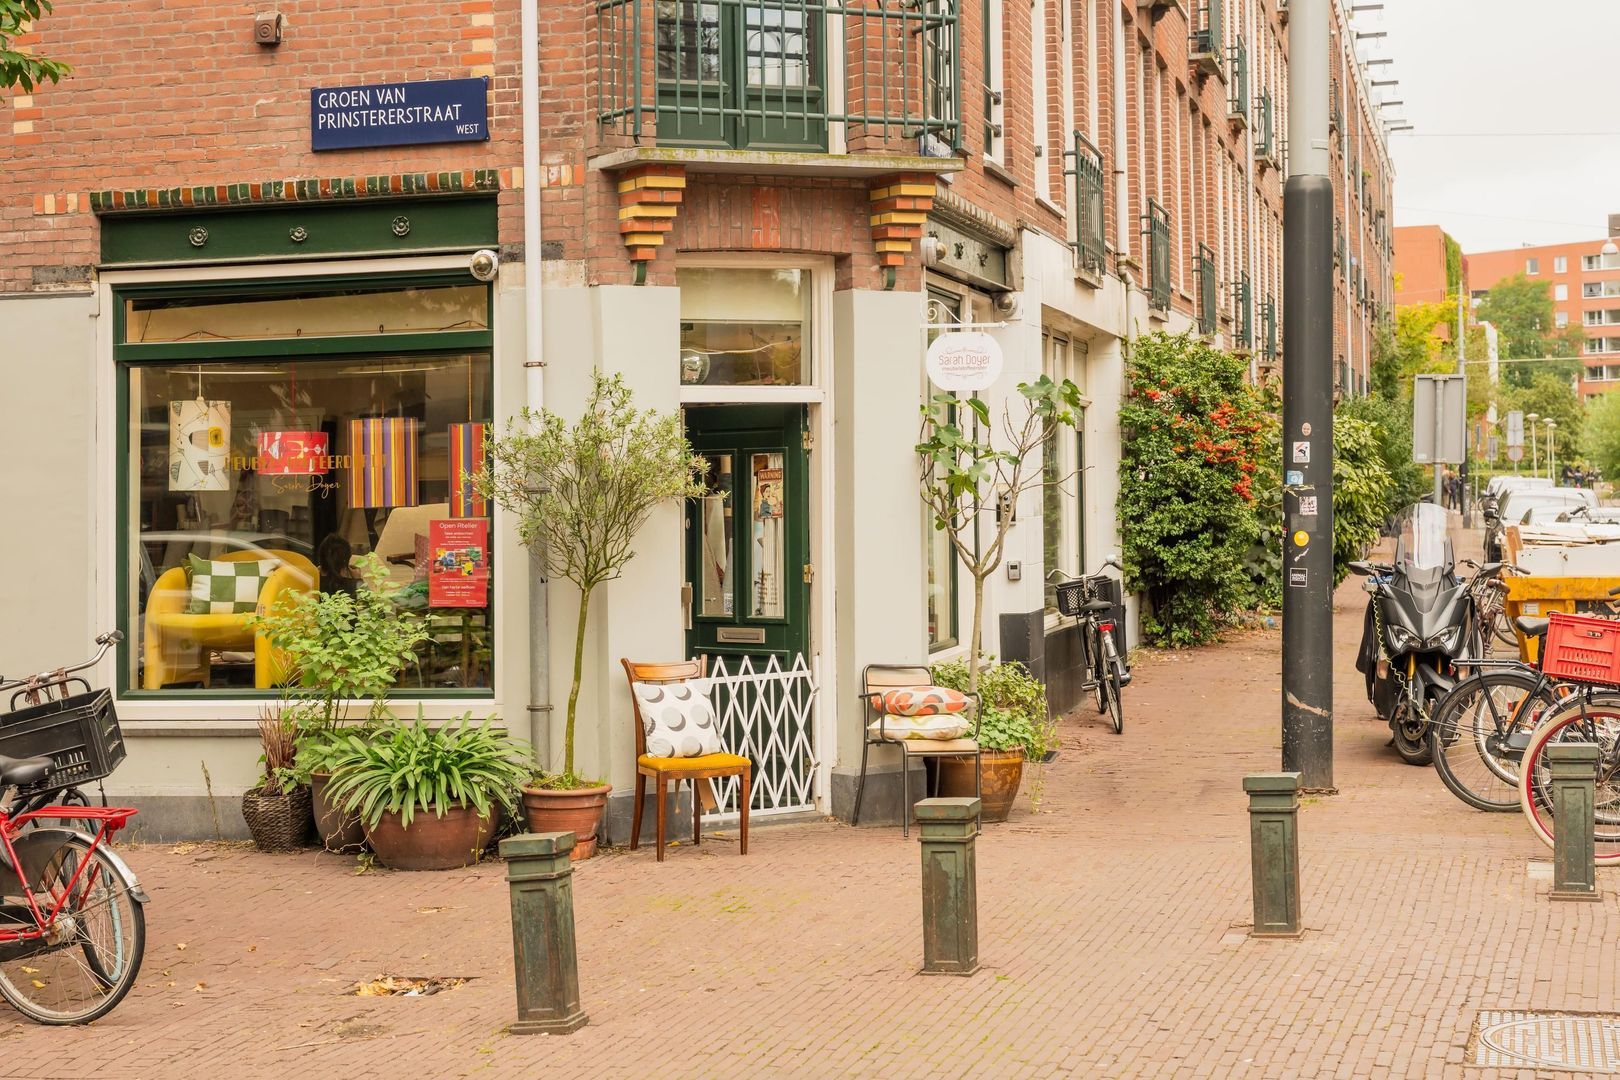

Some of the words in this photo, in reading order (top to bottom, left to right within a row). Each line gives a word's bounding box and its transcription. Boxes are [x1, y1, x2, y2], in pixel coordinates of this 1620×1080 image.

[318, 90, 370, 109] GROEN
[376, 87, 406, 104] VAN
[318, 104, 462, 130] PRINSTERERSTRAAT
[456, 123, 479, 135] WEST
[938, 354, 964, 366] Sarah
[966, 354, 991, 366] Doyer
[304, 474, 342, 500] Doyer
[439, 522, 456, 530] Open
